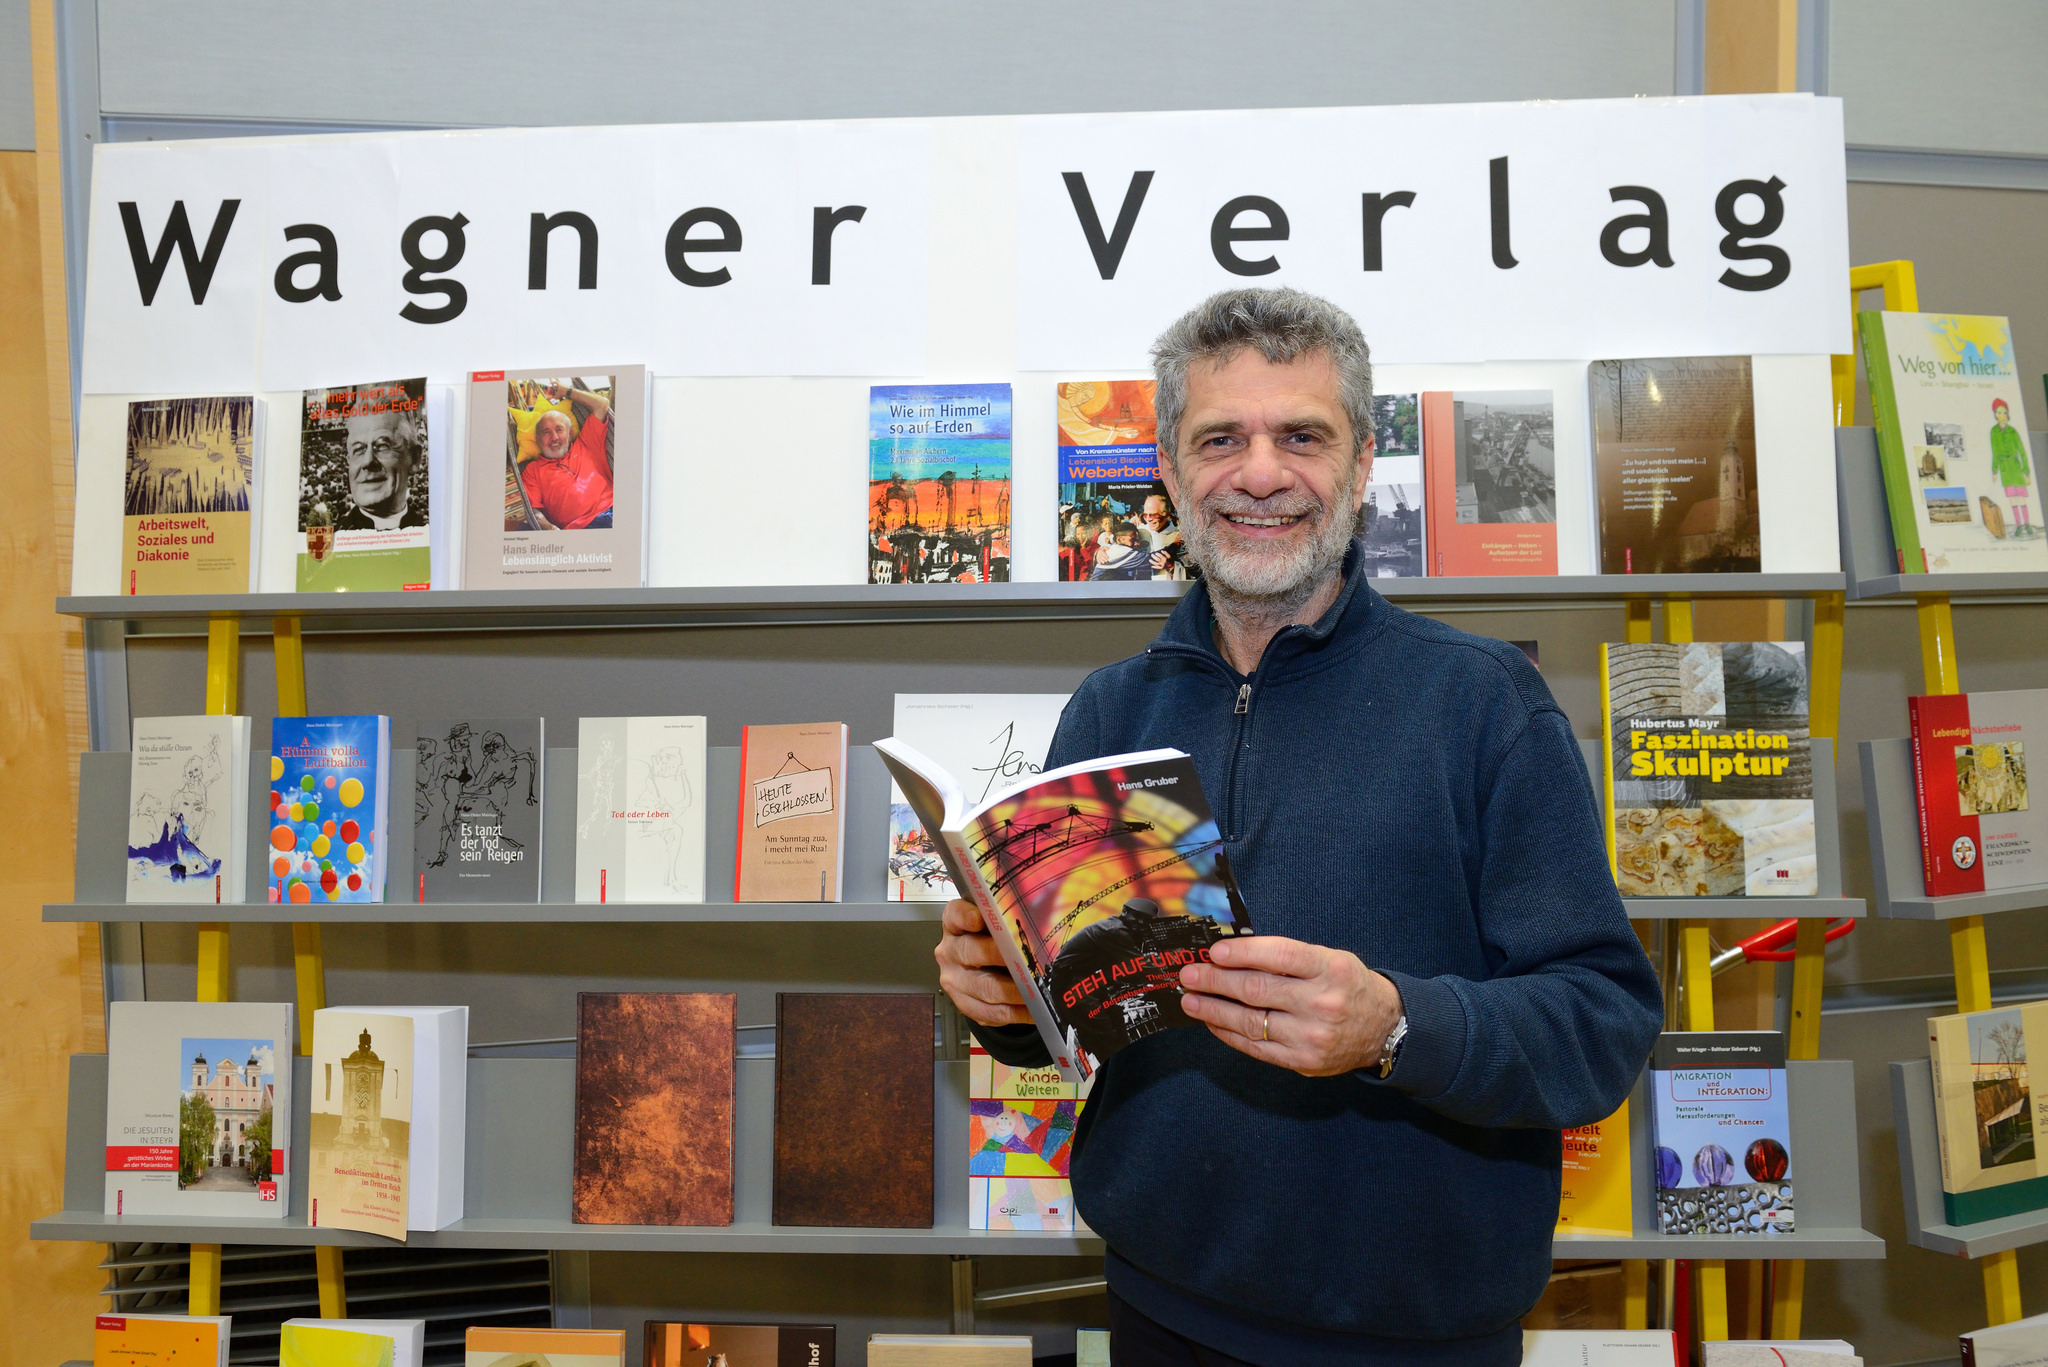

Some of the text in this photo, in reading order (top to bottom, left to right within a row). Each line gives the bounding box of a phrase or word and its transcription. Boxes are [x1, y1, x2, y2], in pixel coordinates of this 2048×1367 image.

[118, 155, 1792, 325] Wagner Verlag
[1898, 355, 1937, 379] Weg
[1938, 361, 1966, 375] von
[327, 389, 357, 404] mehr
[360, 387, 385, 400] wert
[388, 383, 405, 397] als
[309, 405, 339, 421] alles
[342, 402, 368, 418] Gold
[370, 402, 389, 415] der
[890, 402, 991, 418] Wie im Himmel
[889, 420, 972, 434] so auf Erden
[1068, 456, 1153, 465] Lebensbild Bischof
[137, 517, 209, 532] Arbeitswelt,
[137, 532, 214, 546] Soziales und
[137, 548, 189, 562] Diakonie
[503, 544, 564, 555] Hans Riedler
[503, 553, 612, 566] Lebenslänglich Aktivist
[1630, 718, 1720, 731] Hubertus Mayr
[1631, 728, 1789, 750] Faszination
[1932, 728, 1970, 738] Lebendige
[300, 736, 310, 747] A
[281, 745, 359, 757] Hümmi volla
[304, 757, 367, 768] Luftballon
[1631, 750, 1790, 783] Skulptur
[1117, 775, 1179, 792] Hans Gruber
[758, 783, 792, 802] HEUTE
[611, 810, 625, 818] Tod
[646, 810, 670, 818] Leben
[461, 823, 503, 836] Es tanzt
[460, 836, 499, 849] der Tod
[765, 835, 778, 843] Am
[780, 835, 810, 844] Sunntag
[770, 845, 792, 853] mecht
[794, 845, 808, 853] mei
[487, 848, 524, 864] Reigen
[966, 869, 982, 891] UND
[976, 891, 990, 908] AUF
[986, 909, 1002, 932] STEH
[1062, 970, 1108, 1009] STEH
[1111, 956, 1147, 980] AUF
[1150, 949, 1195, 968] UND
[1088, 1006, 1102, 1019] der
[1020, 1072, 1063, 1083] Kinde
[1674, 1072, 1732, 1081] MIGRATION
[1016, 1084, 1060, 1097] Welten
[123, 1126, 174, 1135] DIE JESUITEN
[334, 1168, 401, 1183] Benediktinerstift Lambach
[370, 1180, 388, 1189] Dritten
[389, 1183, 401, 1192] Reich
[260, 1190, 276, 1200] IHS
